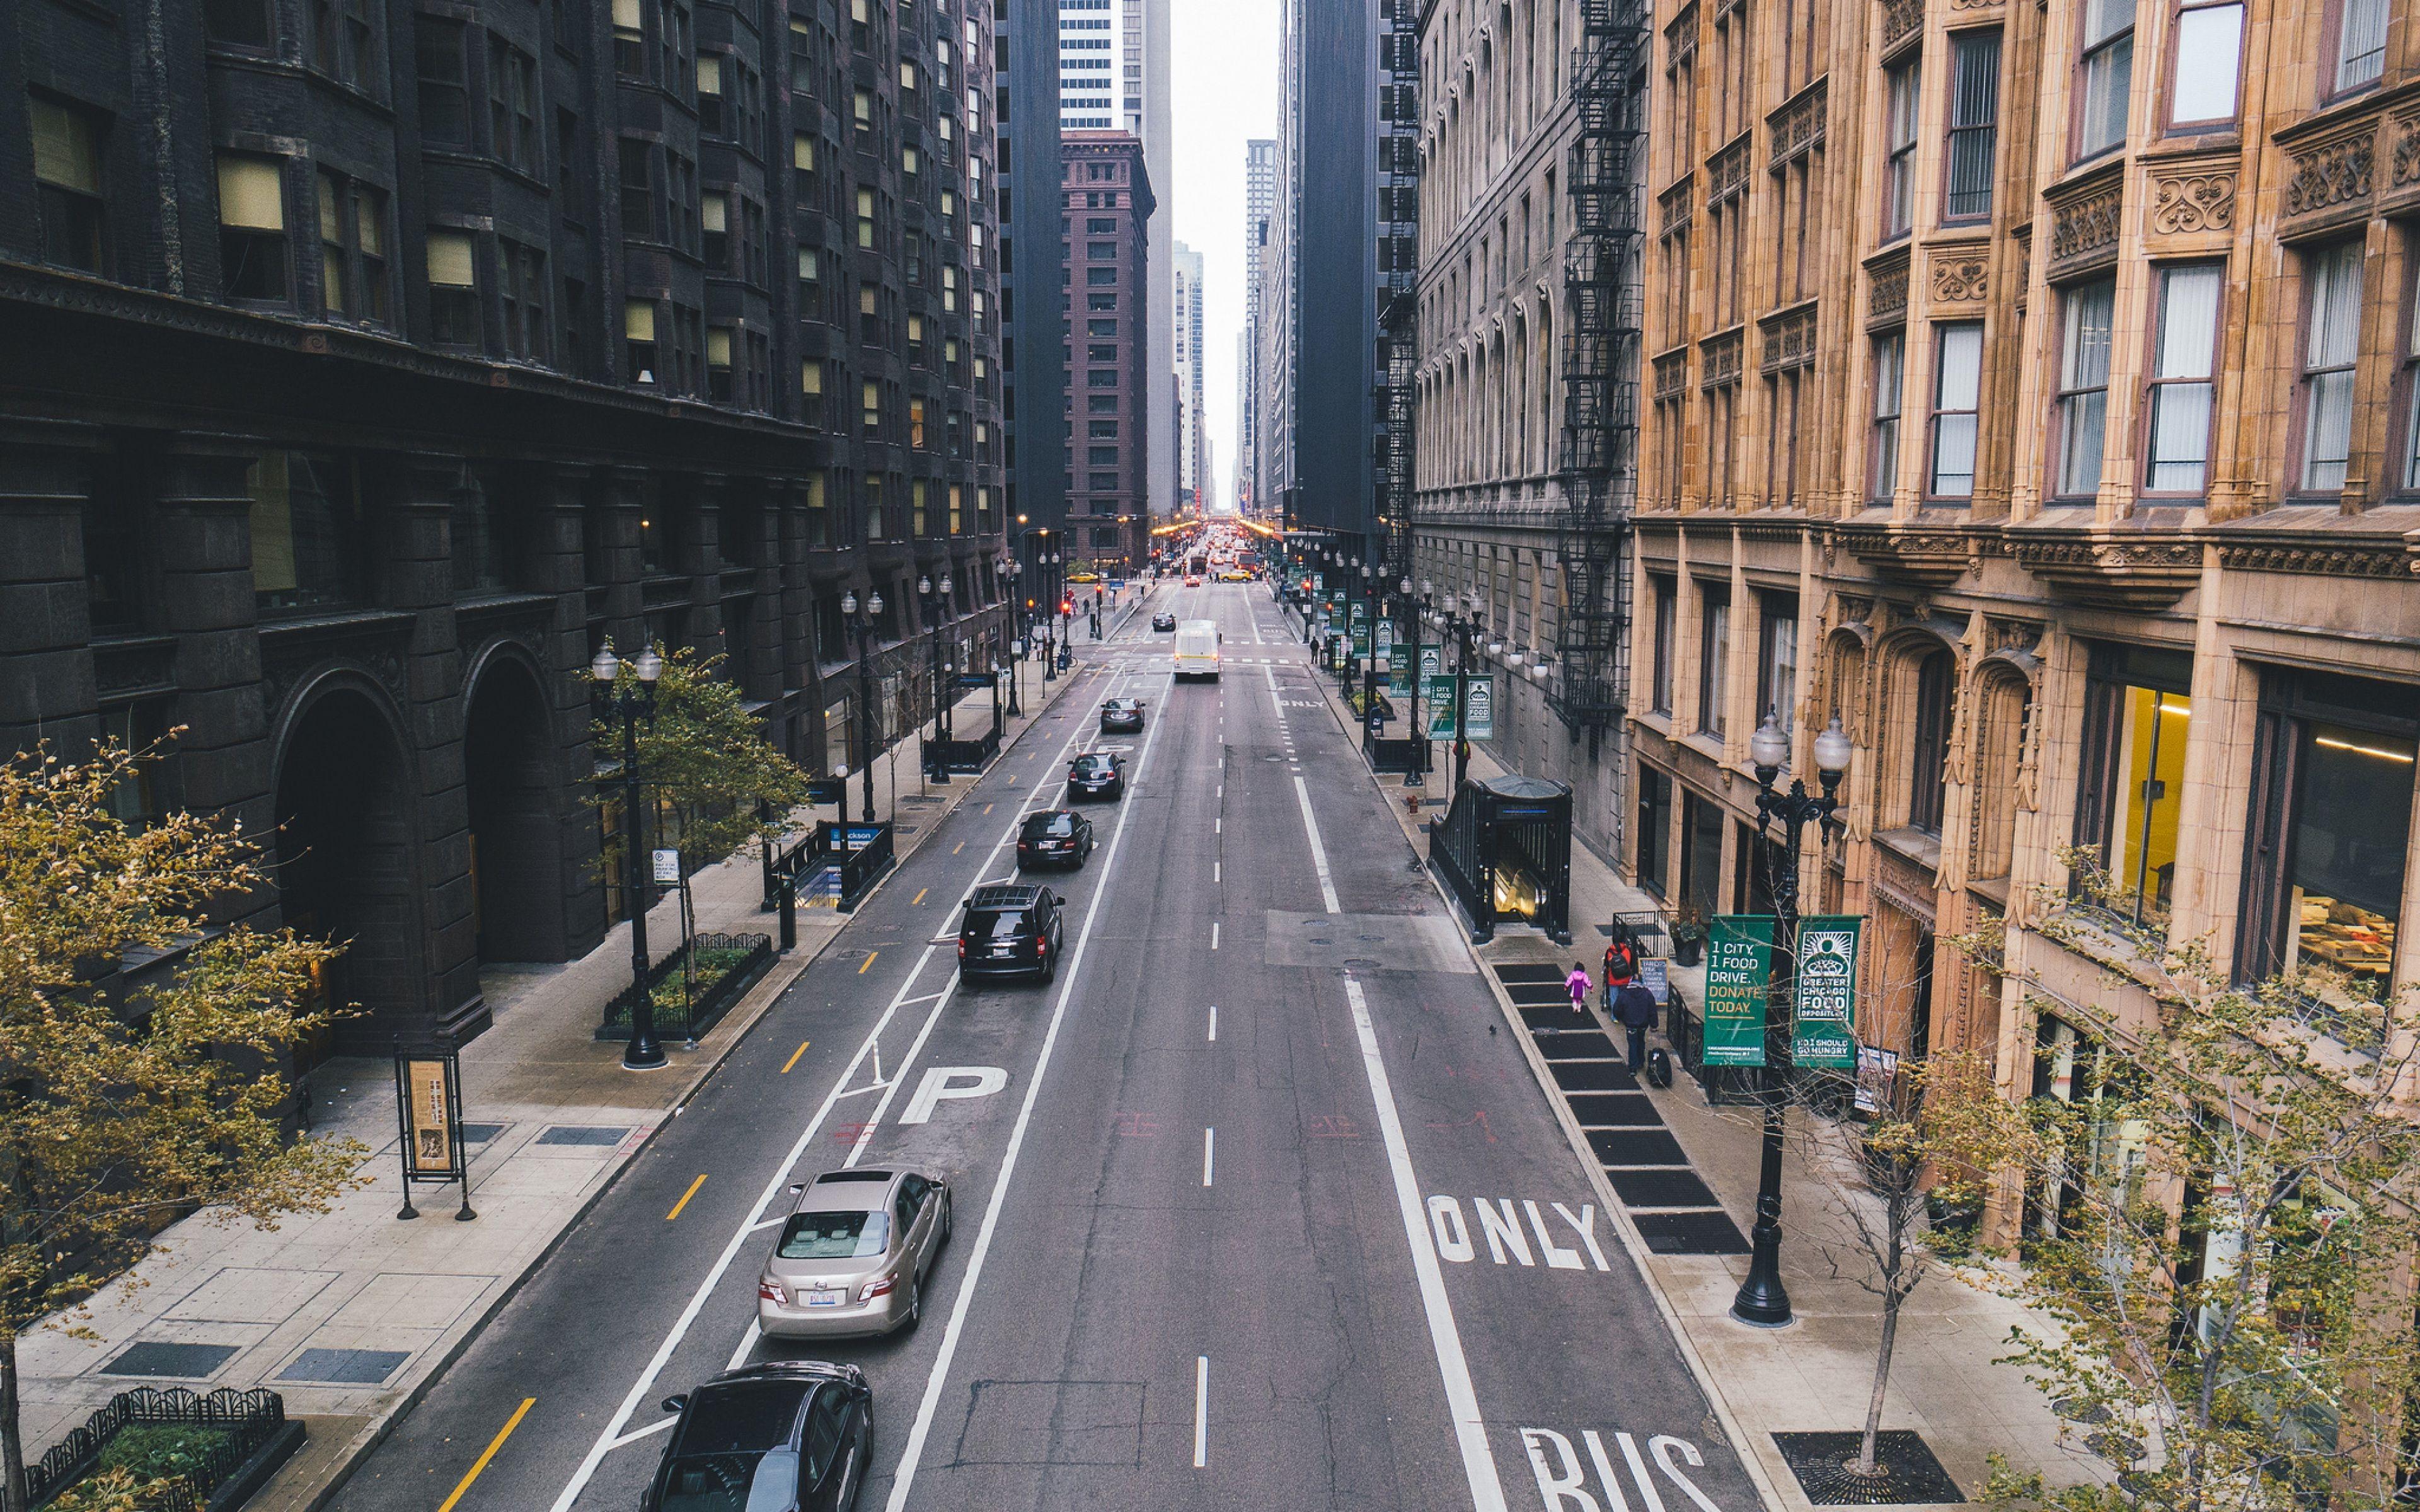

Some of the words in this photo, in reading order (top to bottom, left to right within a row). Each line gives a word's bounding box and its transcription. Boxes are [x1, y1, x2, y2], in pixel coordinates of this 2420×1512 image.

[1712, 941, 1719, 953] 1
[1711, 955, 1718, 968] 1
[1722, 958, 1758, 969] FOOD
[1710, 971, 1751, 983] DRIVE.
[1709, 986, 1762, 999] DONATE
[1708, 1001, 1750, 1013] TODAY.
[1802, 997, 1845, 1009] FOOD
[898, 1066, 1008, 1124] P
[1427, 1194, 1611, 1271] ONLY
